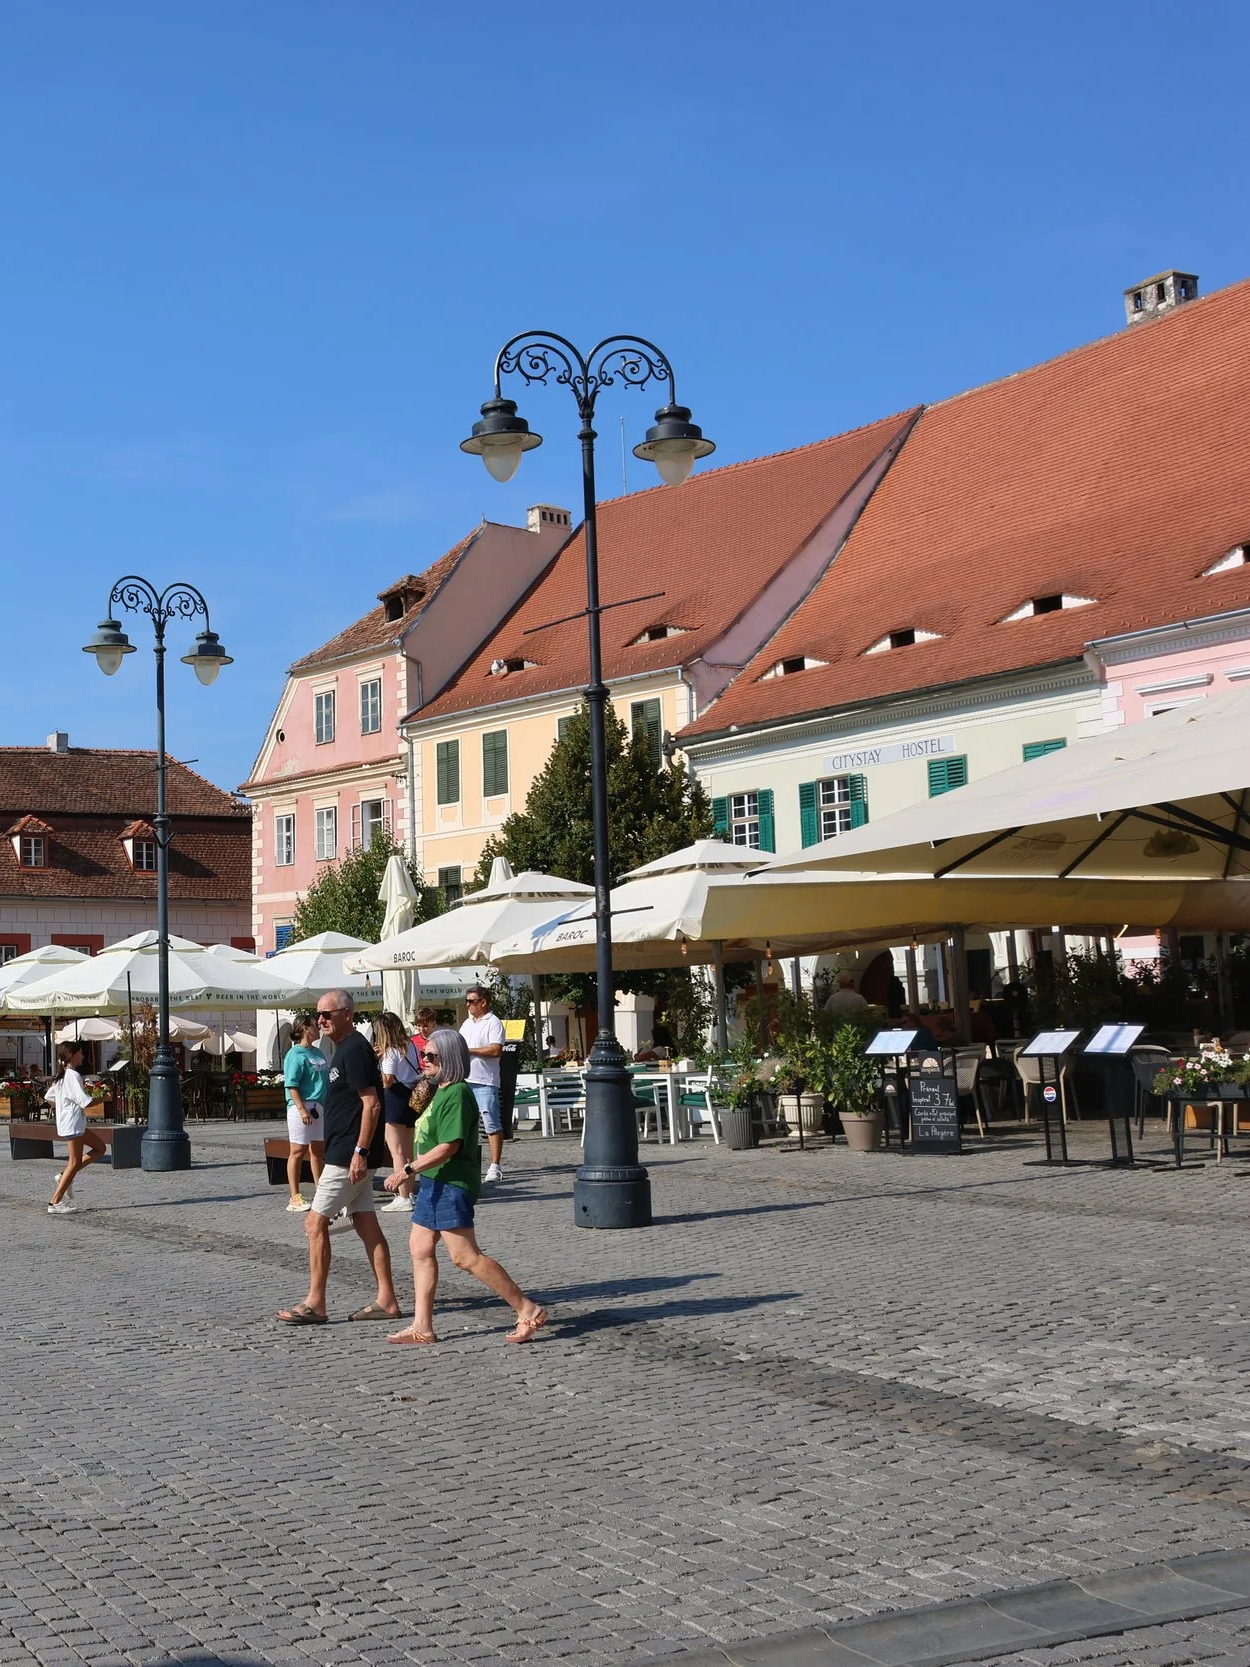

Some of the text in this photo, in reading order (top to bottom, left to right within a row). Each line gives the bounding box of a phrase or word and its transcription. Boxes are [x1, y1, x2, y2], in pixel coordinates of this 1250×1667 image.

[832, 738, 945, 770] CITYSTAY HOSTEL
[555, 929, 588, 942] BAROC
[393, 950, 416, 963] BAROC
